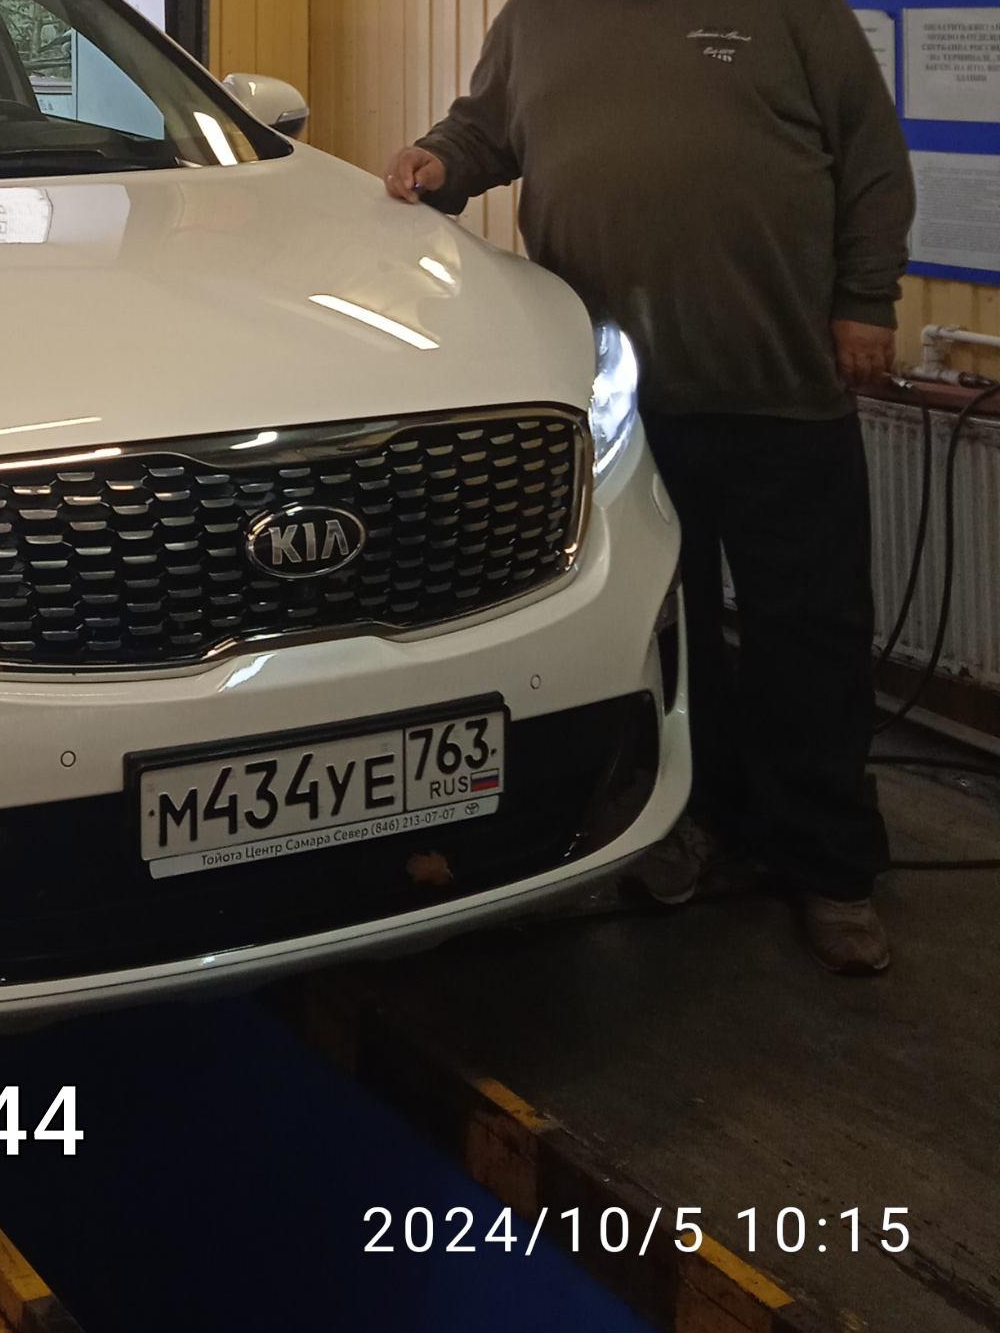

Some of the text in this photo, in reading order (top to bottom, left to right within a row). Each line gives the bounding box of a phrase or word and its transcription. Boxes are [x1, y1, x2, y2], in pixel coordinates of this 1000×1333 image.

[268, 519, 349, 565] KIA
[408, 717, 490, 782] 763
[429, 775, 470, 799] RUS
[201, 807, 455, 867] Тойота Центр Самара Север (846) 213-07-07
